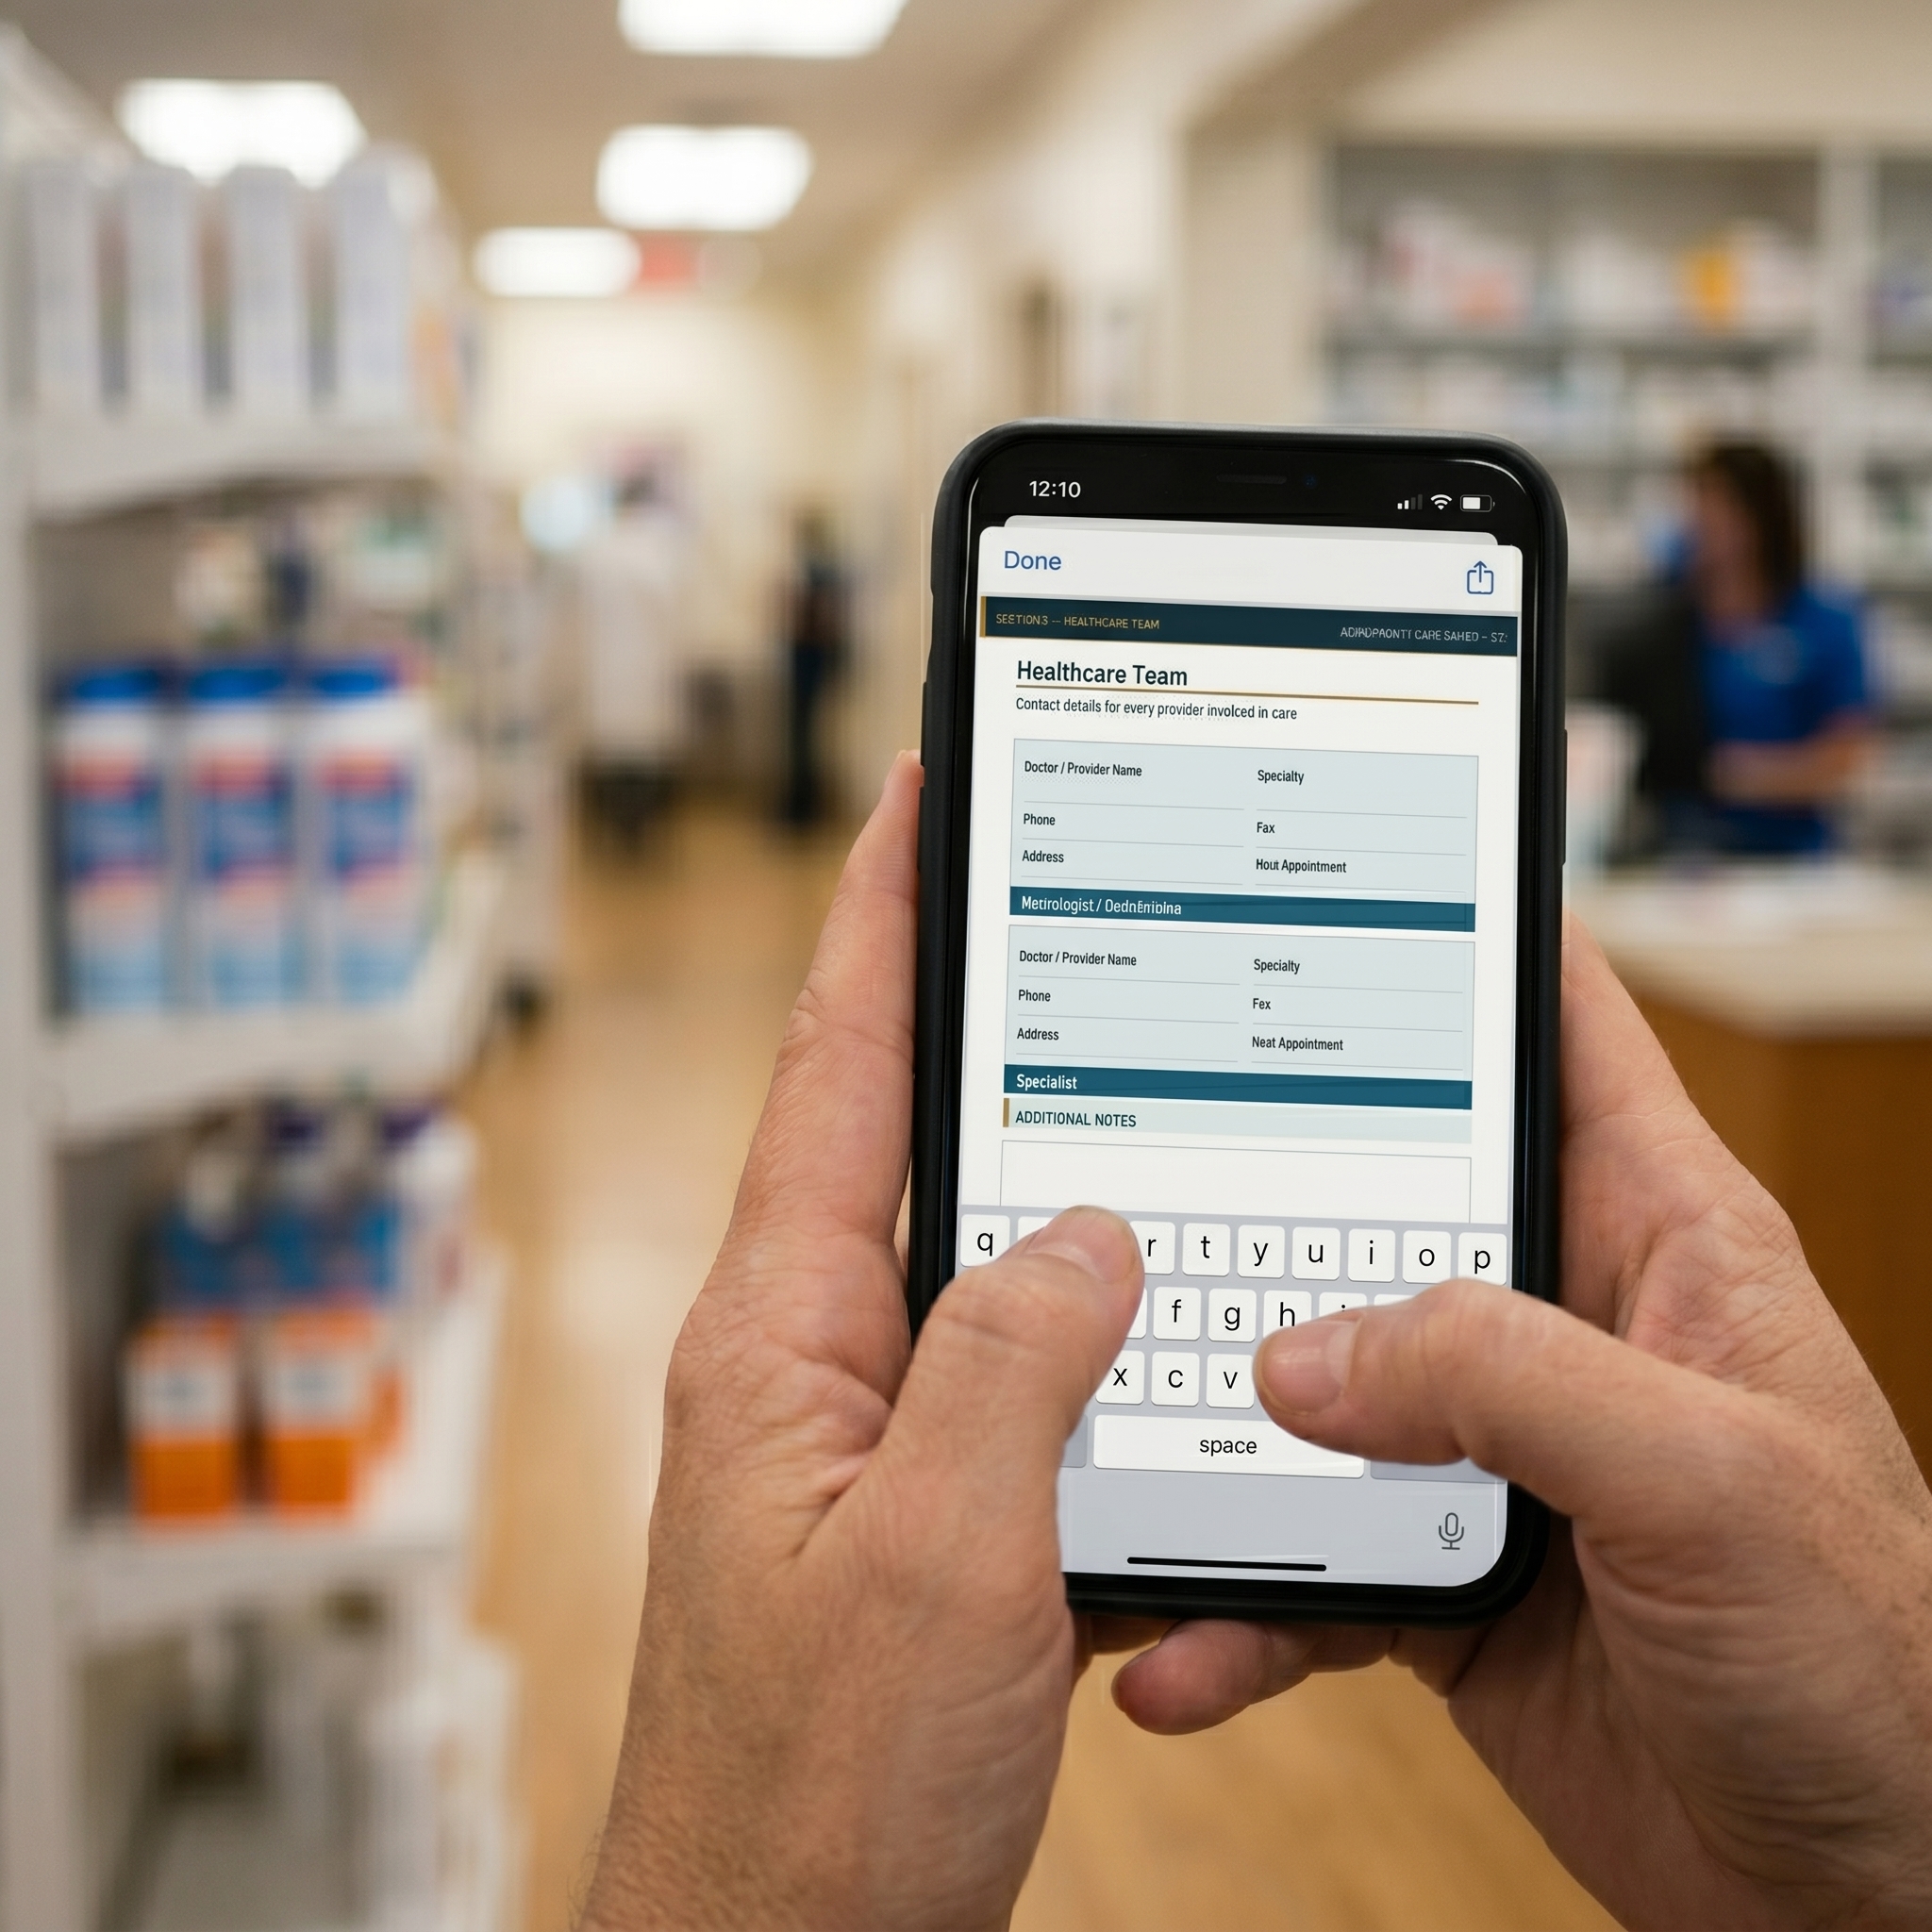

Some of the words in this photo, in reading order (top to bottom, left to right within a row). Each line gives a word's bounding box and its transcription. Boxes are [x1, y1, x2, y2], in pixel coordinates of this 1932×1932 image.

[1029, 480, 1081, 498] 12:10
[1004, 550, 1062, 571] Done
[1065, 617, 1128, 628] HEALTHCARE
[1131, 619, 1159, 629] TEAM
[1415, 630, 1441, 640] CARE
[1017, 659, 1127, 684] Healthcare
[1132, 664, 1188, 687] Team
[1015, 697, 1061, 711] Contact
[1063, 698, 1102, 713] details
[1104, 699, 1122, 713] for
[1123, 703, 1156, 718] every
[1157, 702, 1205, 719] provider
[1257, 705, 1269, 719] in
[1272, 708, 1298, 720] care
[1024, 760, 1059, 774] Doctor
[1059, 761, 1066, 774] /
[1067, 761, 1111, 775] Provider
[1112, 763, 1142, 777] Name
[1257, 769, 1305, 786] Specialty
[1023, 812, 1056, 826] Phone
[1257, 821, 1275, 834] Fax
[1022, 849, 1065, 863] Address
[1280, 858, 1347, 874] Appointment
[1095, 898, 1103, 912] /
[1019, 950, 1054, 963] Doctor
[1055, 950, 1060, 963] /
[1061, 951, 1106, 965] Provider
[1108, 953, 1137, 967] Name
[1253, 958, 1301, 975] Specialty
[1018, 989, 1051, 1003] Phone
[1252, 997, 1272, 1010] Fex
[1016, 1027, 1059, 1041] Address
[1252, 1036, 1276, 1049] Neat
[1277, 1036, 1344, 1052] Appointment
[1016, 1073, 1078, 1091] Specialist
[1015, 1110, 1091, 1126] ADDITIONAL
[1094, 1113, 1137, 1128] NOTES
[976, 1232, 993, 1257] q
[1147, 1239, 1158, 1257] r
[1200, 1235, 1211, 1259] t
[1253, 1241, 1269, 1267] y
[1307, 1243, 1324, 1263] u
[1369, 1240, 1374, 1265] i
[1418, 1248, 1436, 1267] o
[1474, 1250, 1491, 1274] p
[1171, 1298, 1182, 1324] f
[1224, 1307, 1241, 1332] g
[1279, 1301, 1296, 1327] h
[1112, 1365, 1129, 1388] x
[1168, 1369, 1184, 1389] c
[1223, 1371, 1239, 1390] v
[1199, 1439, 1257, 1457] space
